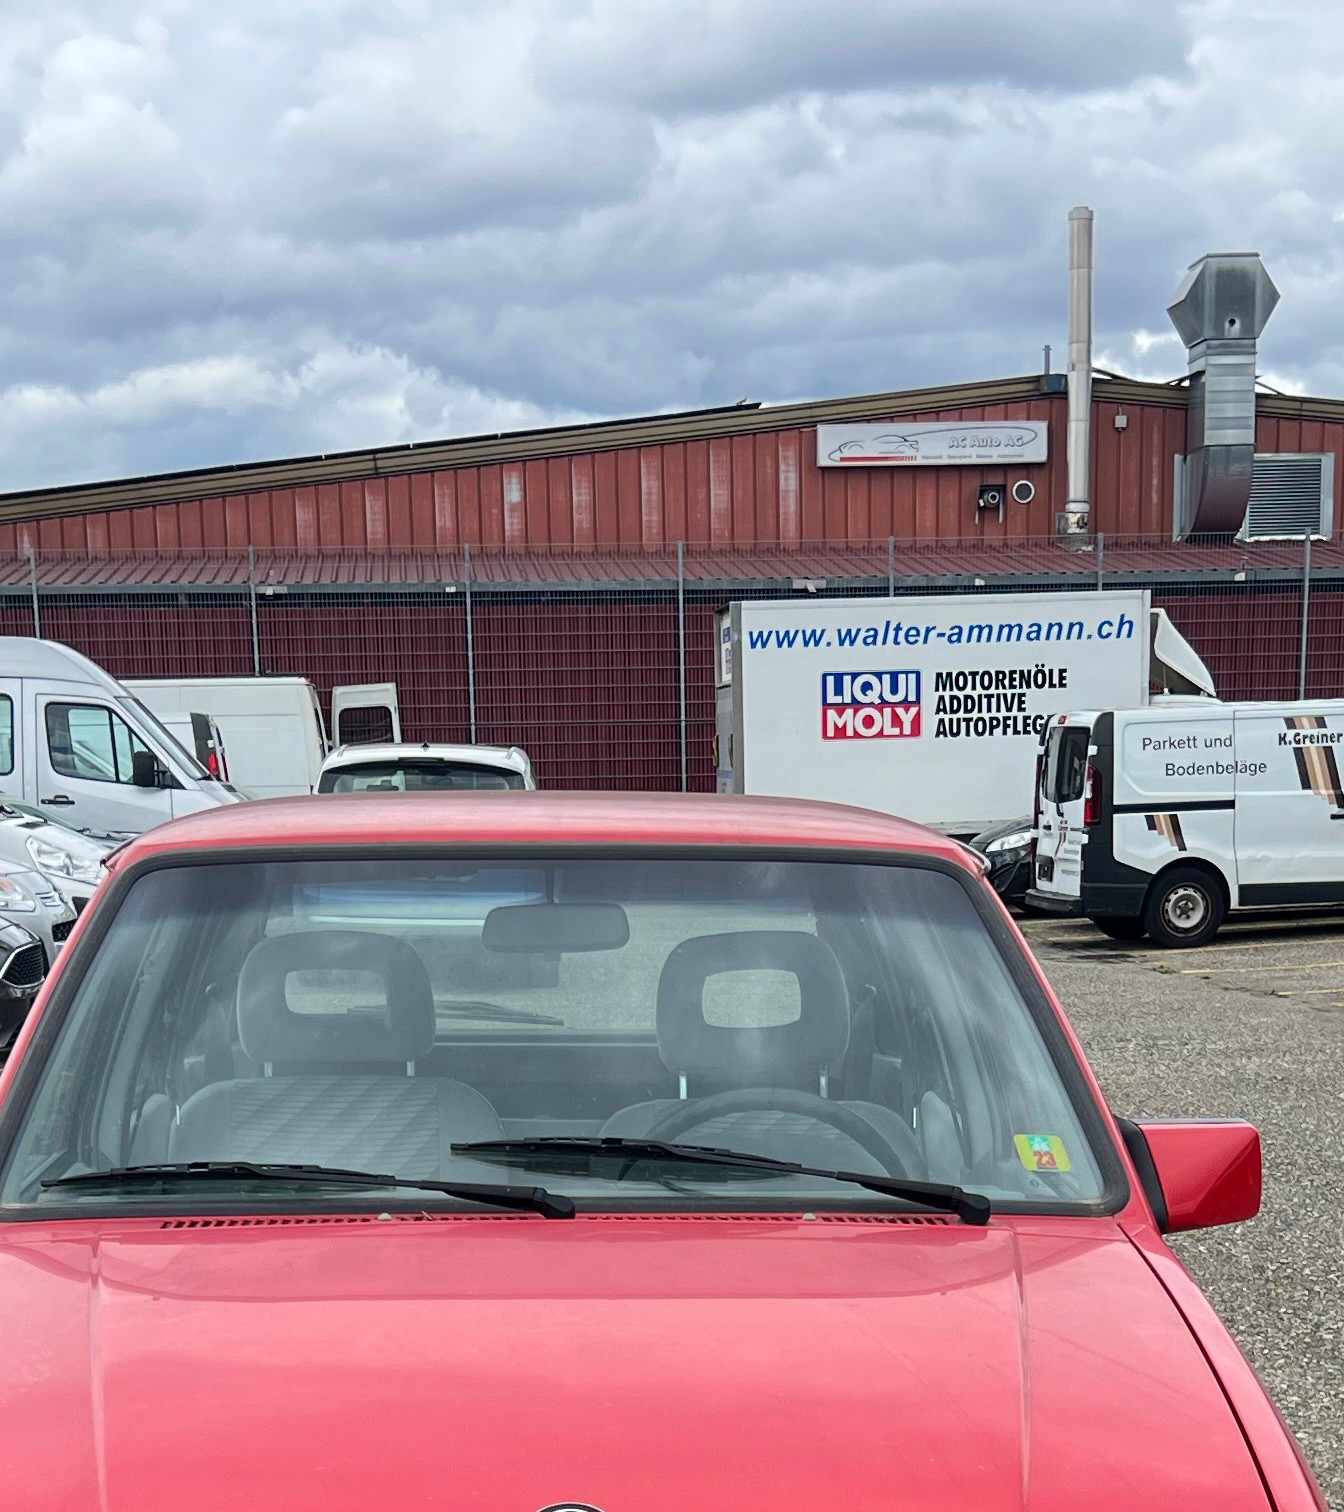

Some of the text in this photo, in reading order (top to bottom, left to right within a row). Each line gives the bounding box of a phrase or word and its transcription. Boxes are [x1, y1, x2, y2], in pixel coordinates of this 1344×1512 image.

[969, 436, 1001, 448] Auto
[748, 614, 1134, 649] www.walter-ammann.ch
[826, 673, 917, 705] LIQUI
[934, 664, 1067, 692] MOTORENÖLE
[934, 692, 1027, 715] ADDITIVE
[826, 707, 919, 737] MOLY
[934, 714, 1051, 738] AUTOPFLEG
[1142, 734, 1233, 751] Parkett und
[1278, 732, 1344, 746] K.Greiner
[1165, 760, 1267, 777] Bodenbeläge
[1033, 1150, 1058, 1168] 23
